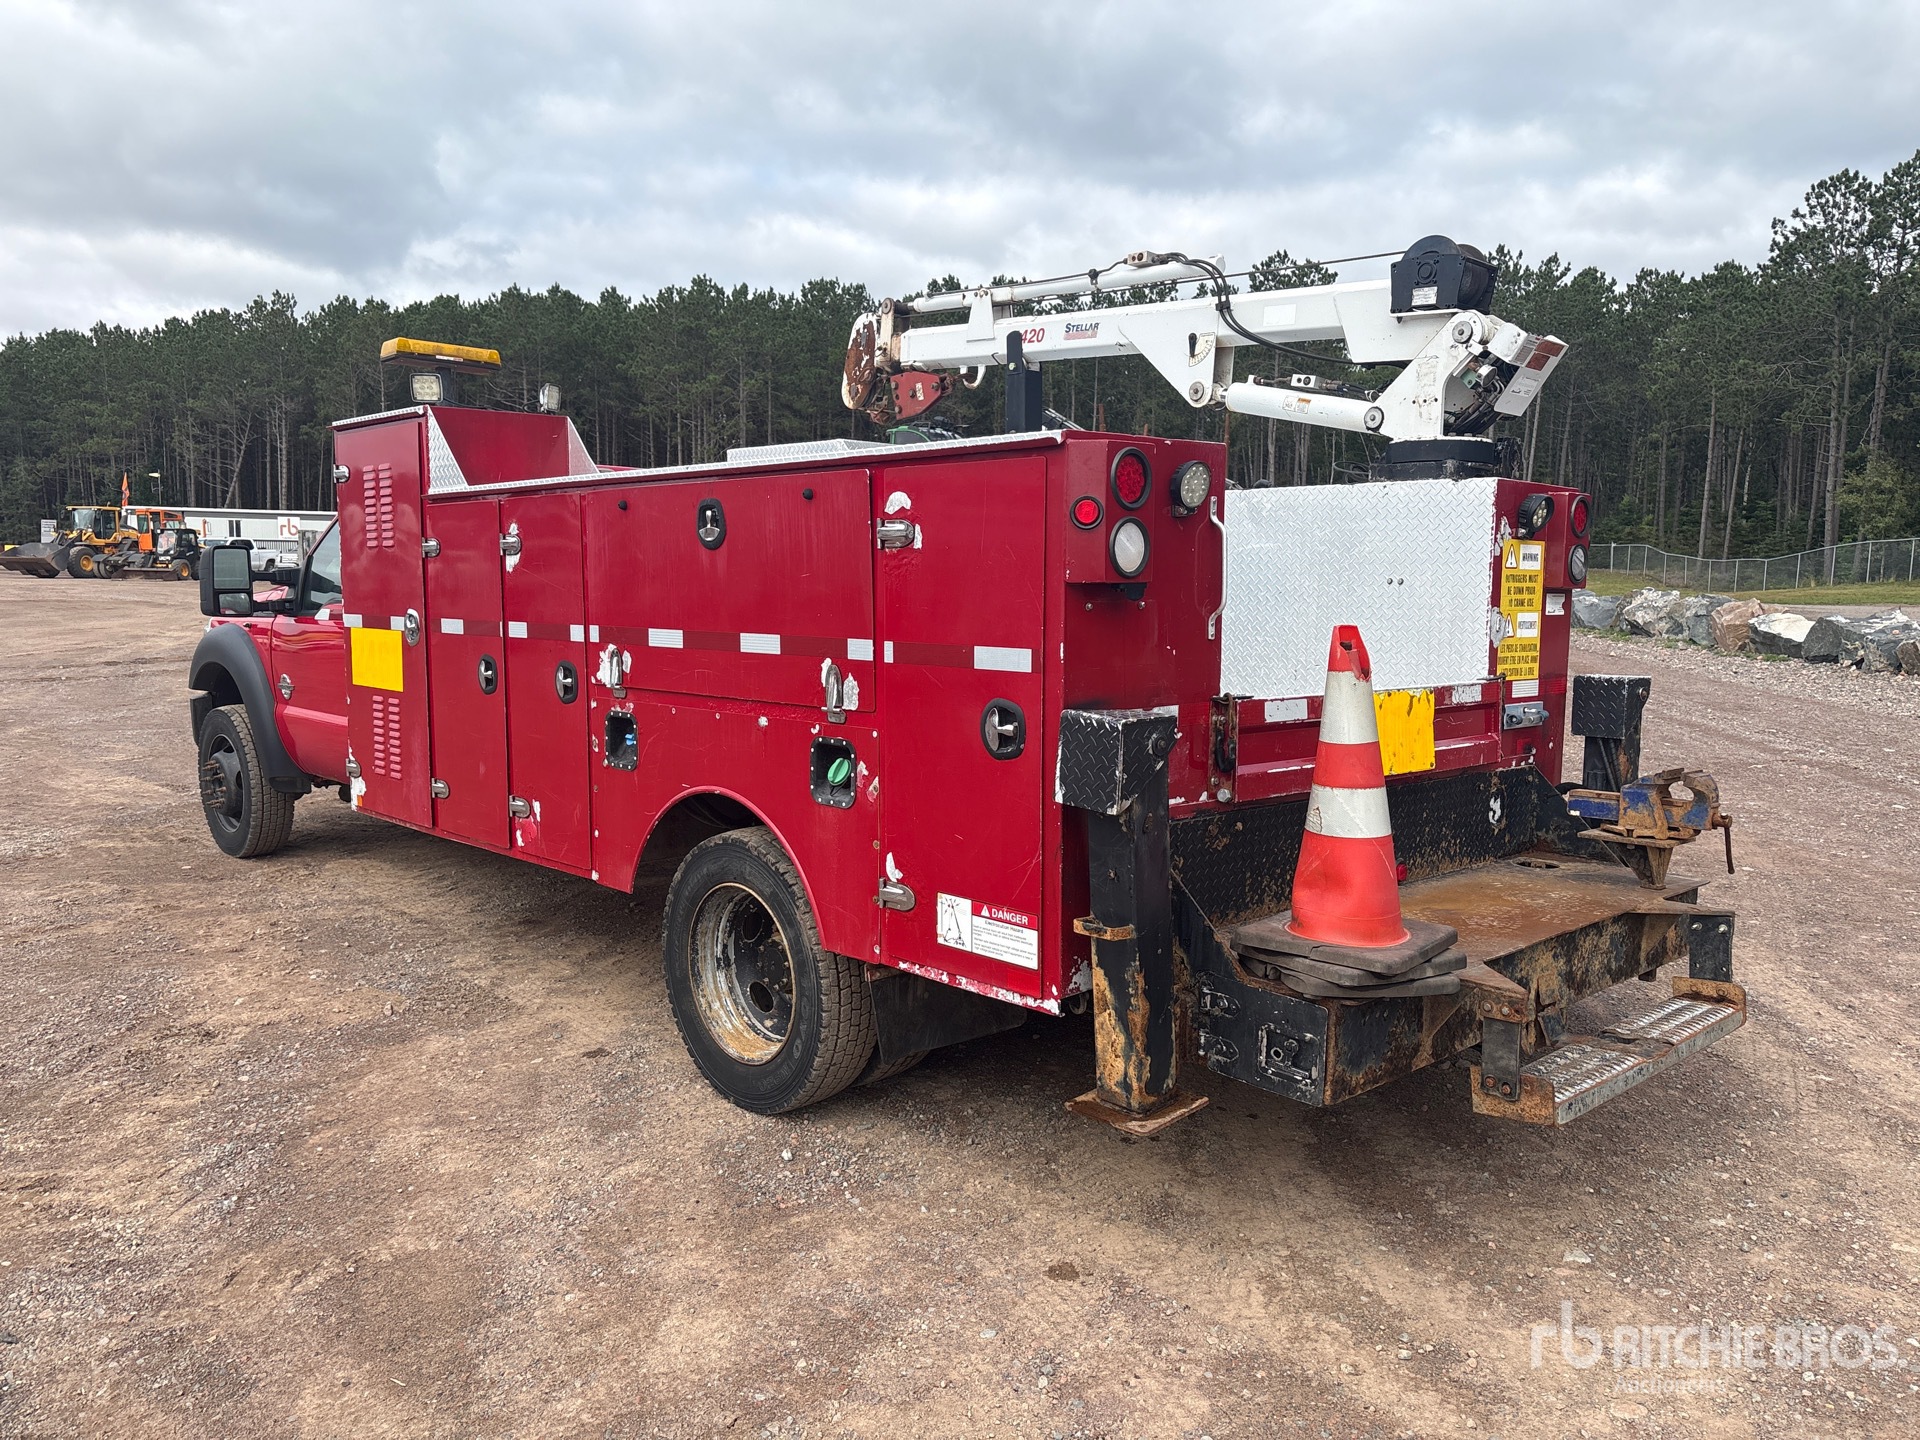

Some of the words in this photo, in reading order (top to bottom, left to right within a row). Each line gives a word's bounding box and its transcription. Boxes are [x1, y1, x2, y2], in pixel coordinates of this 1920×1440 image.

[1065, 322, 1100, 333] STELLAR
[1522, 552, 1539, 562] WARNING
[1505, 573, 1527, 584] OUTRIGGERS
[1528, 574, 1539, 583] MUST
[1507, 585, 1512, 595] BE
[1513, 586, 1524, 595] DOWN
[1525, 586, 1535, 595] PRIOR
[1513, 598, 1526, 608] CRANE
[1526, 598, 1534, 607] USE
[991, 908, 1029, 926] DANGER
